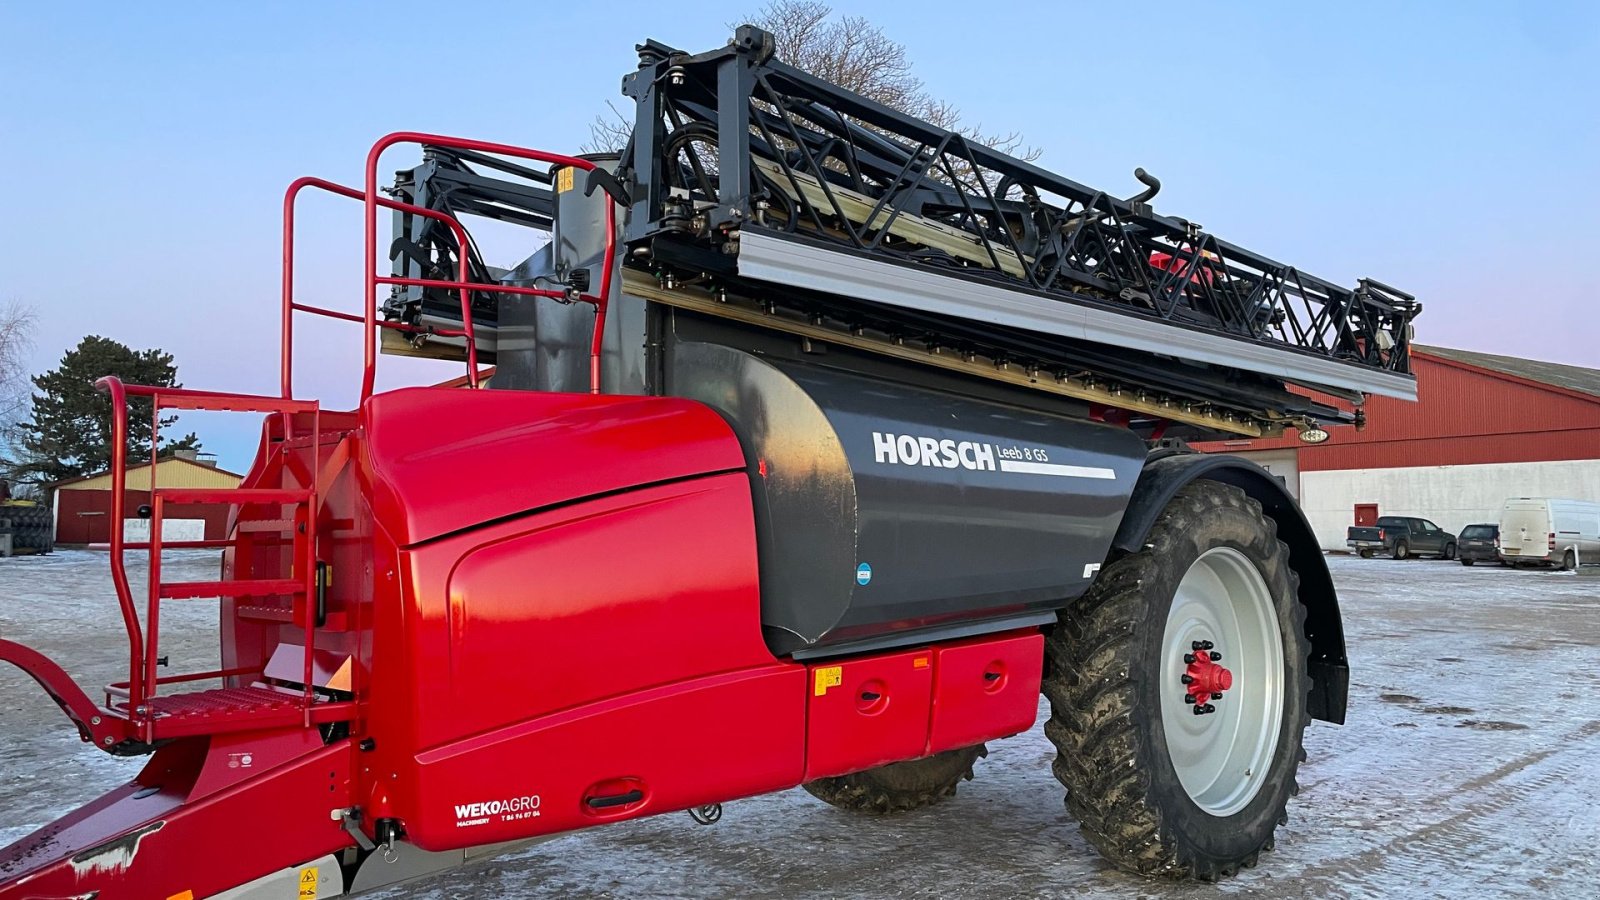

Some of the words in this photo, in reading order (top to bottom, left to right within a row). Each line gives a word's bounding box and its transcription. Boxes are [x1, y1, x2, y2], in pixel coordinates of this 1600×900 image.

[872, 432, 996, 471] HORSCH
[995, 444, 1023, 460] Leeb
[1024, 448, 1033, 461] 8
[1033, 449, 1049, 462] GS
[456, 818, 490, 828] MACHINERY
